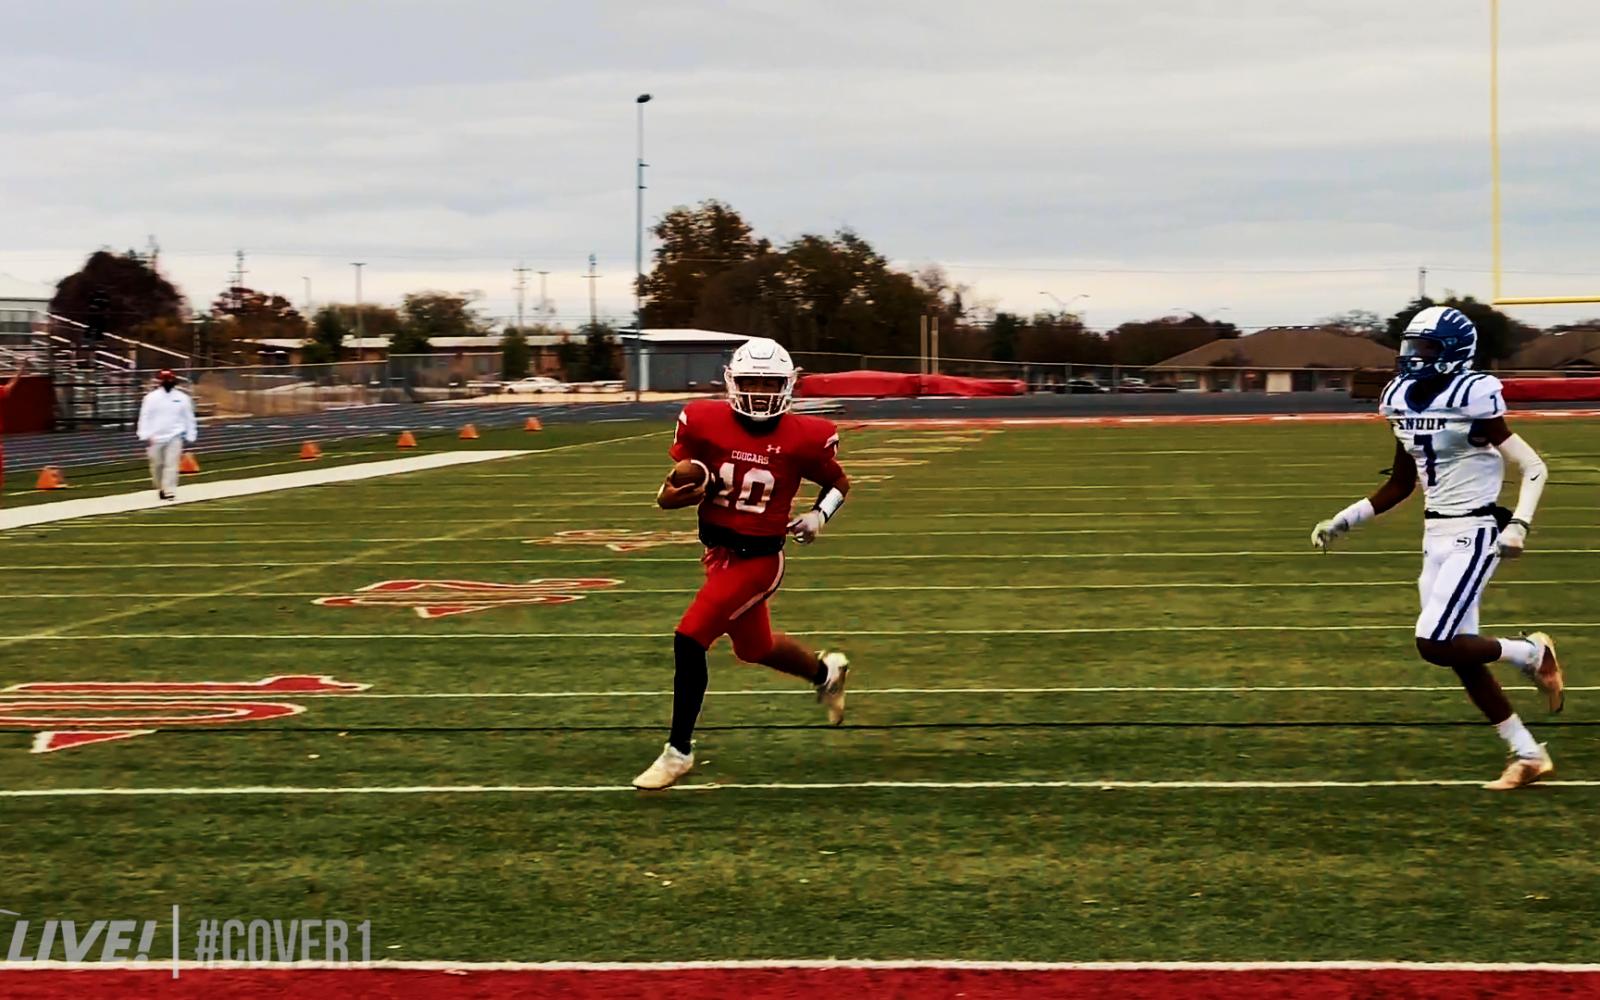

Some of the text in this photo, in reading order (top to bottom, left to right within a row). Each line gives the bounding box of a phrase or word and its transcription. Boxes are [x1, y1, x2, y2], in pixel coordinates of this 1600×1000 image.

[731, 450, 769, 465] COUGARS
[1413, 433, 1437, 487] 7
[712, 462, 776, 514] 10
